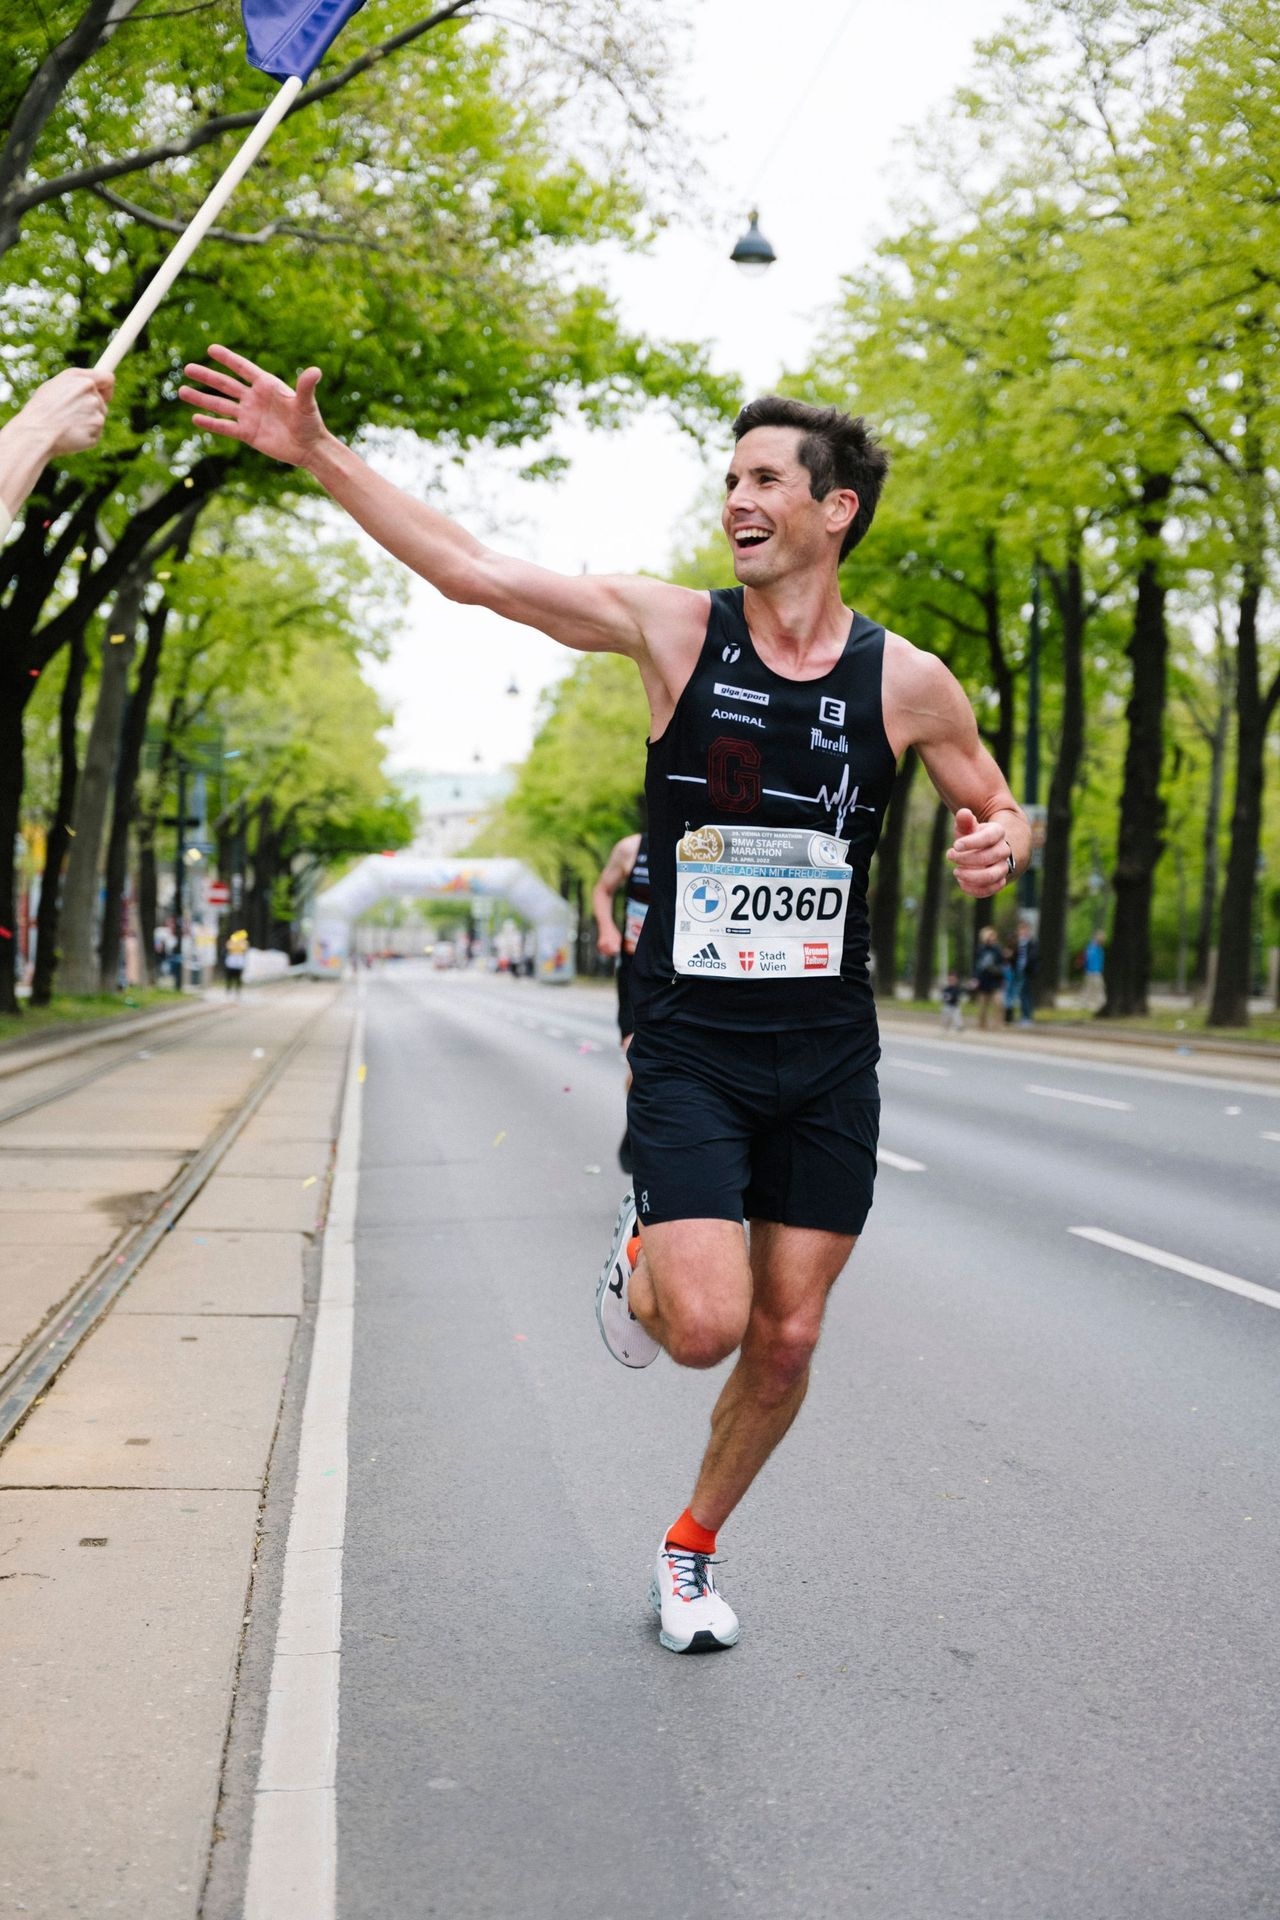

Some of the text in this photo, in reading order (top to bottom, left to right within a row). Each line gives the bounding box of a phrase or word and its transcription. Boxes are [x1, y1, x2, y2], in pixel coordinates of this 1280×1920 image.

[721, 687, 767, 702] giga sport
[711, 708, 766, 729] ADMIRAL
[810, 727, 849, 754] Murelli
[707, 736, 762, 814] G
[731, 838, 794, 849] BMW STAFFEL
[731, 847, 782, 857] MARATHON
[702, 864, 767, 877] AUFGELADEN
[769, 867, 787, 878] MIT
[731, 885, 843, 922] 2036D
[759, 951, 786, 961] Stadt
[687, 958, 727, 970] adidas
[760, 962, 787, 972] Wien
